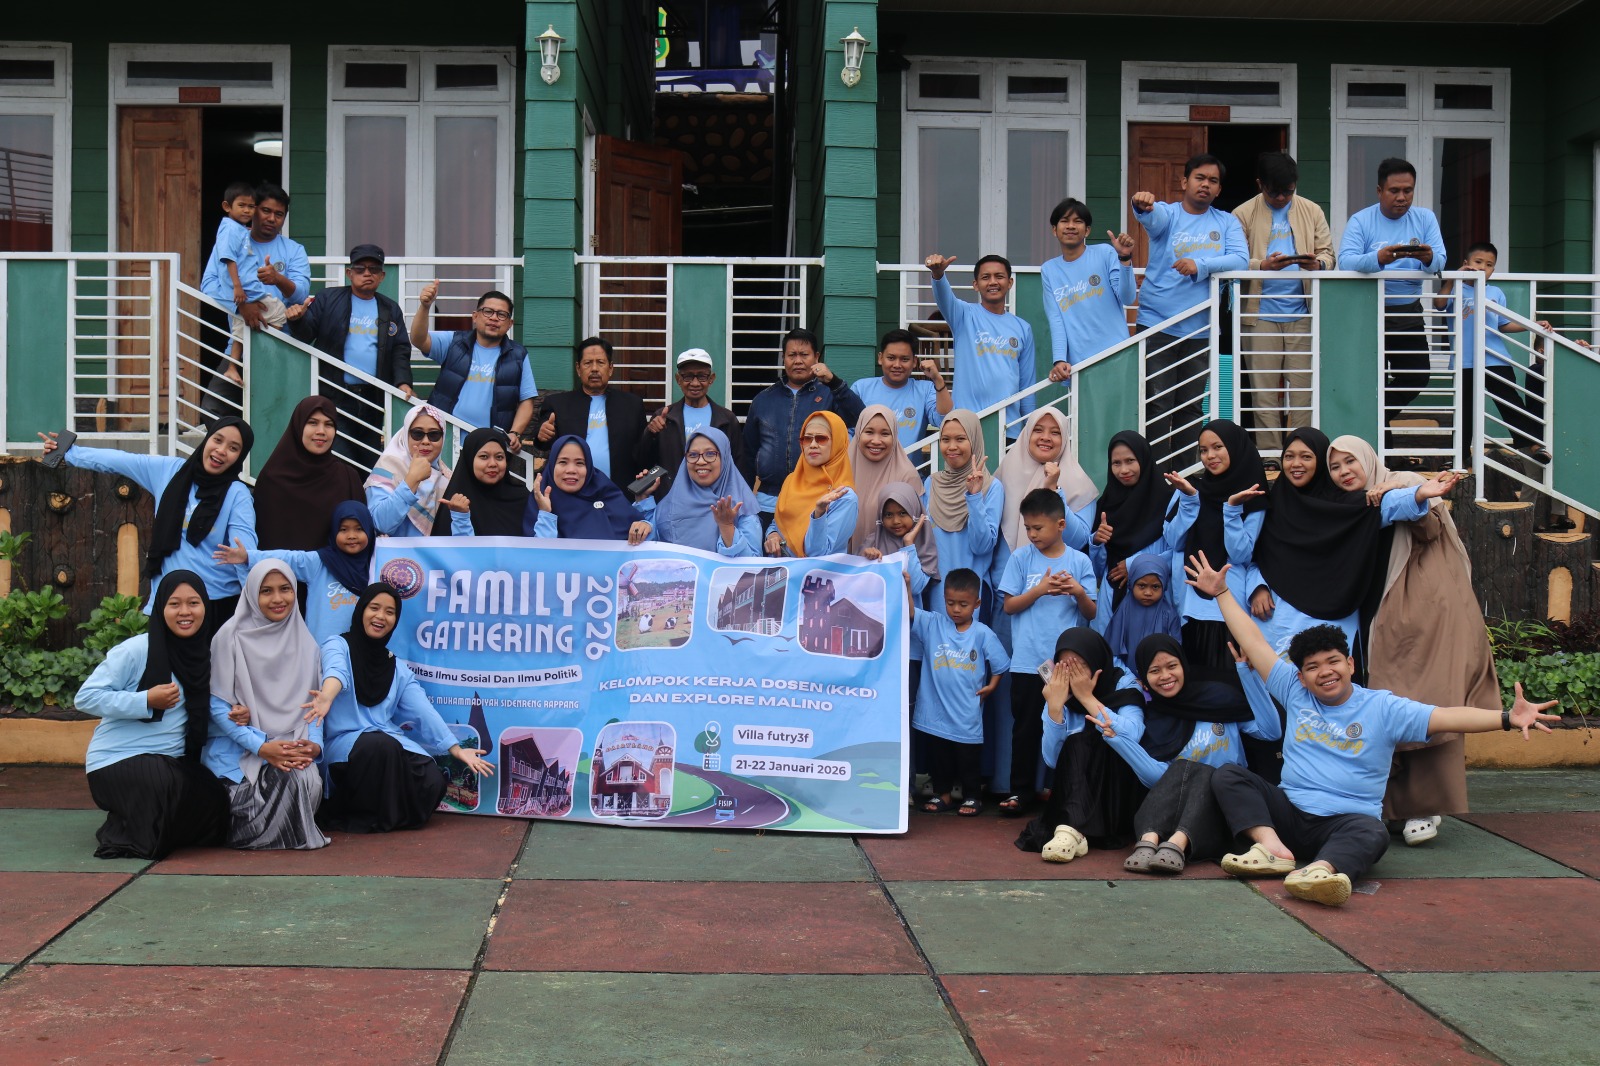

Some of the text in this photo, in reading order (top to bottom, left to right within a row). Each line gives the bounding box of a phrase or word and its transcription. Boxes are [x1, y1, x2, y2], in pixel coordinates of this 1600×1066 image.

[426, 569, 581, 617] FAMILY
[585, 575, 614, 661] 2026
[416, 620, 573, 655] GATHERING
[407, 664, 578, 684] ultas Ilmu Sosial Dan Ilmu Politik
[599, 675, 878, 699] KELOMPOK KERJA DOSEN (KKD)
[436, 696, 499, 707] MUHAMMADIYAH
[501, 699, 542, 708] SIDENRENG
[543, 700, 579, 709] RAPPANG
[629, 693, 833, 711] DAN EXPLORE MALINO
[1296, 708, 1346, 738] Family
[738, 729, 810, 744] Villa futry3f
[735, 759, 847, 776] 21-22 Januari 2026
[718, 799, 733, 808] FISIP
